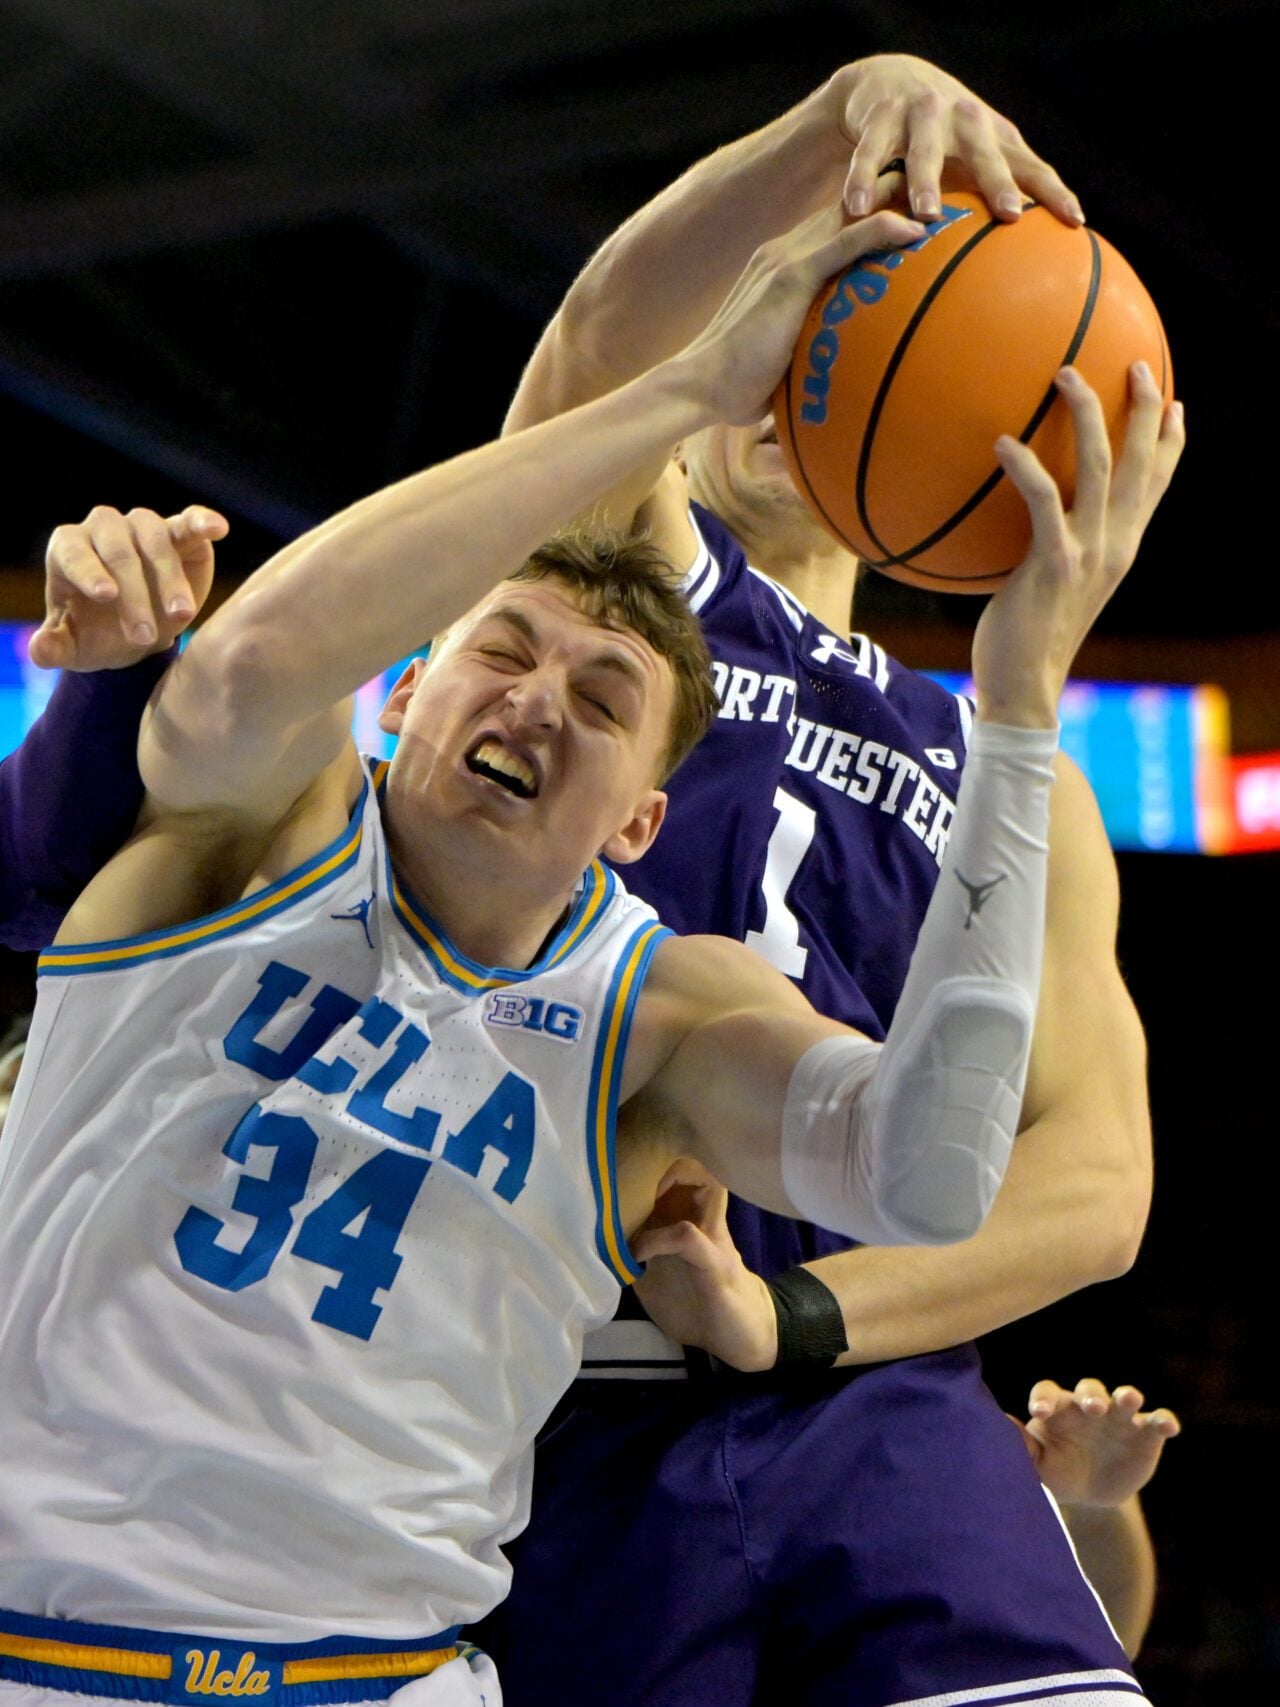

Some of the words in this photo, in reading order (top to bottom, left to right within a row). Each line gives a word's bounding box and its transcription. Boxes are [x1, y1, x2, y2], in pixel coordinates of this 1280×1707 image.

[744, 786, 817, 980] 1
[223, 960, 536, 1205] UCLA
[173, 1101, 433, 1342] 34
[184, 1648, 271, 1697] Ucla
